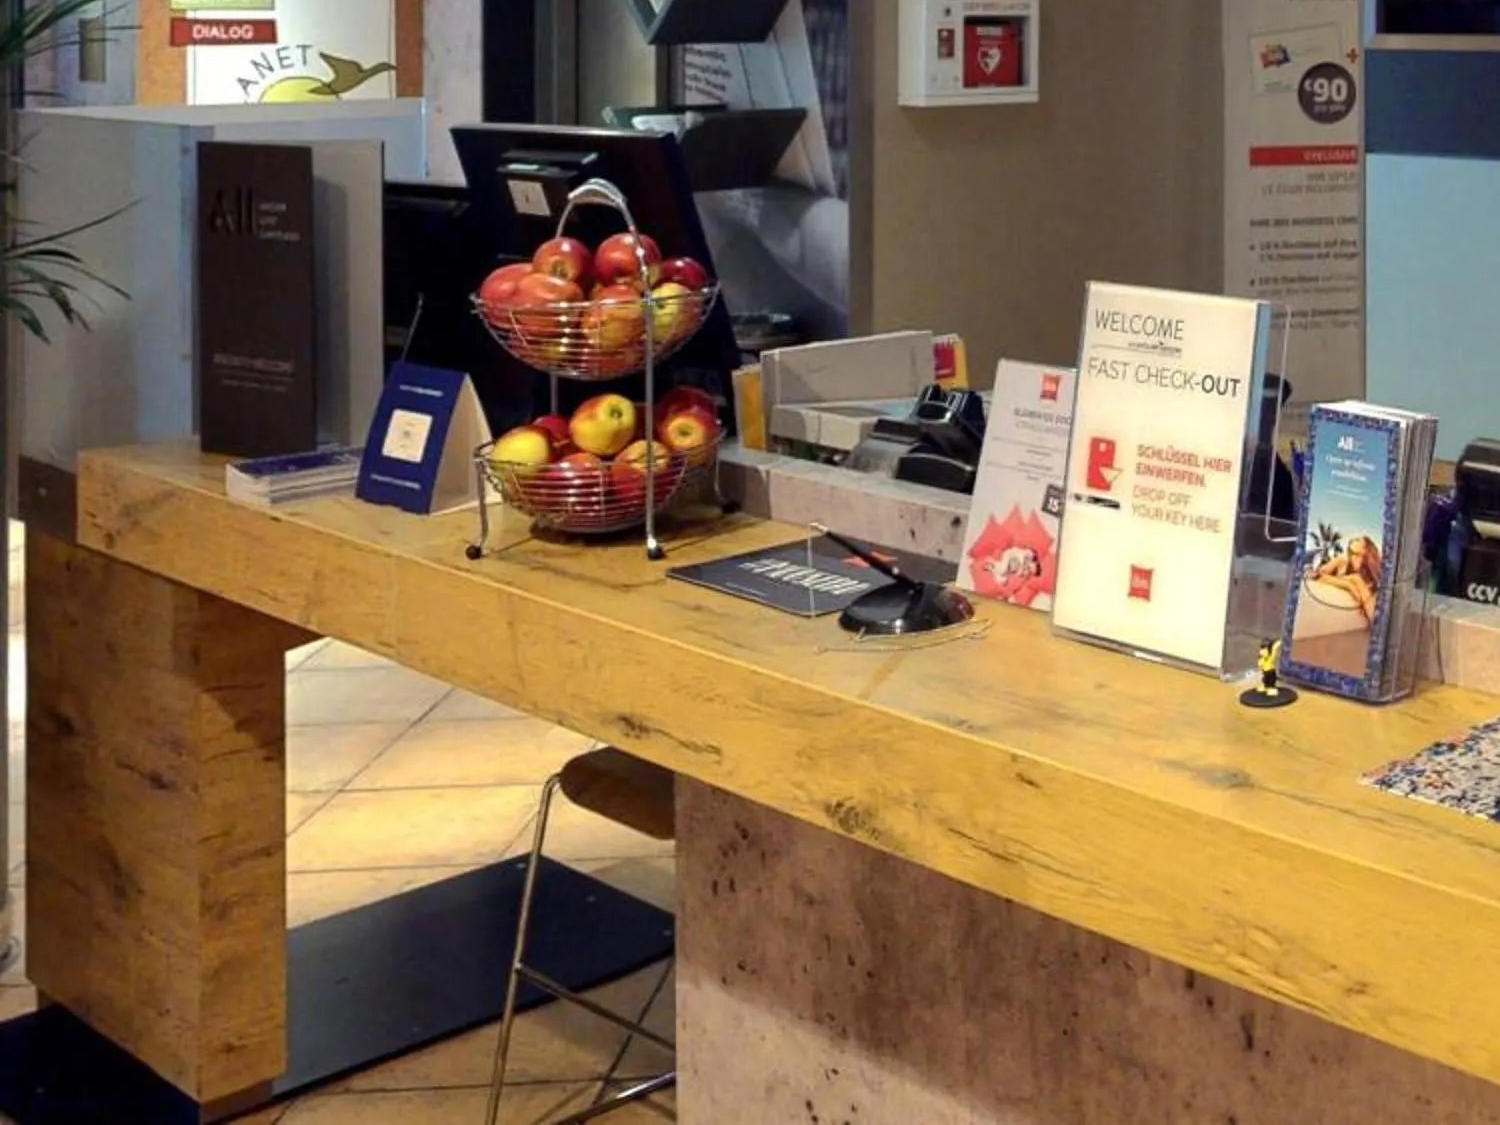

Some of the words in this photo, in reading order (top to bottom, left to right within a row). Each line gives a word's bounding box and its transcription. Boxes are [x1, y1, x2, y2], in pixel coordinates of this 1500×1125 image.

[191, 23, 254, 40] DIALOG
[1095, 308, 1185, 341] WELCOME
[1088, 355, 1131, 382] FAST
[1134, 362, 1241, 398] CHECK-OUT
[1137, 443, 1201, 468] SCHLÜSSEL
[1203, 457, 1232, 474] HIER
[1168, 492, 1192, 508] OFF
[1467, 582, 1499, 602] CCV
